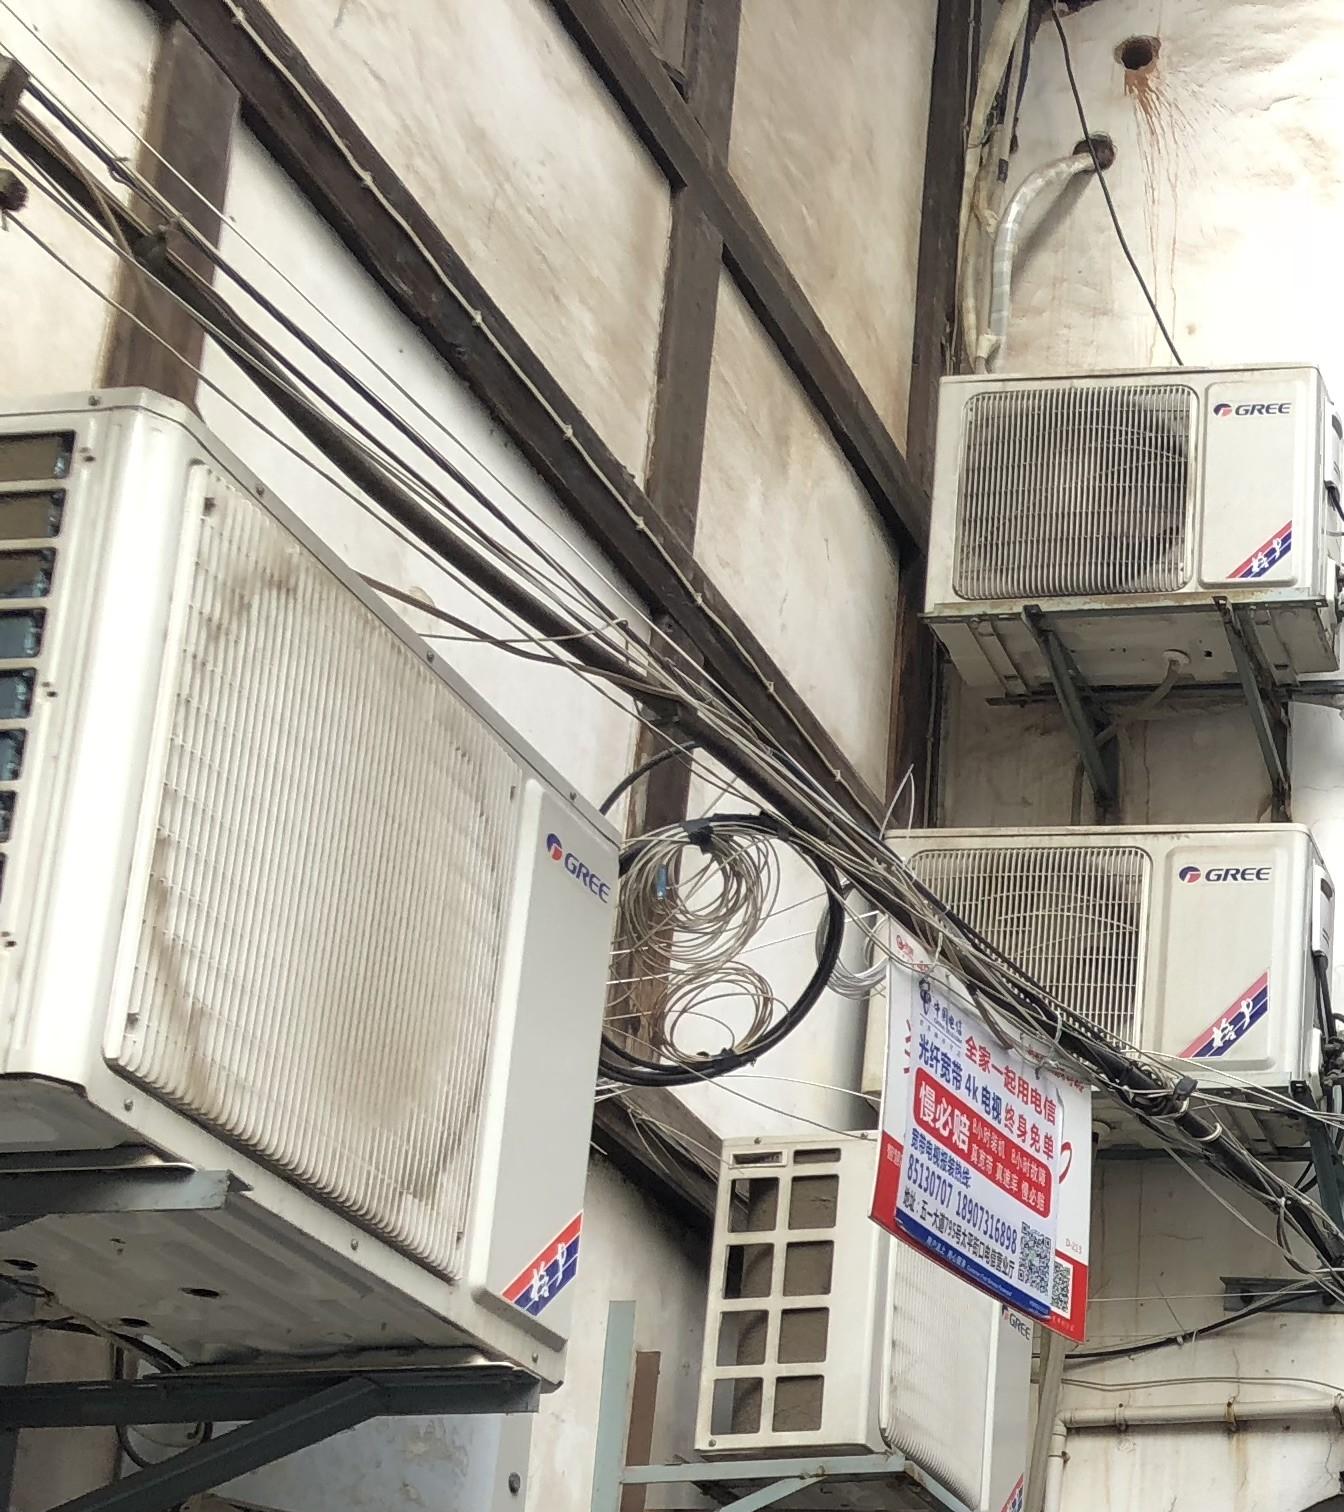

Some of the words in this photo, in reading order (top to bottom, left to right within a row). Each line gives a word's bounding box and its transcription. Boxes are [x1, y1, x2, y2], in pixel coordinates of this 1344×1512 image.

[1234, 401, 1291, 416] GREE
[562, 849, 612, 907] GREE
[1204, 866, 1272, 882] GREE
[918, 1033, 962, 1091] 光纤宽带
[981, 1087, 1002, 1125] 电视
[1004, 1103, 1055, 1161] 终身免单
[965, 1036, 1056, 1126] 全家一起用电信
[918, 1081, 970, 1153] 慢必赔
[907, 1153, 953, 1209] 85130707
[956, 1190, 1017, 1254] 18907316898
[1008, 1311, 1031, 1341] GREE
